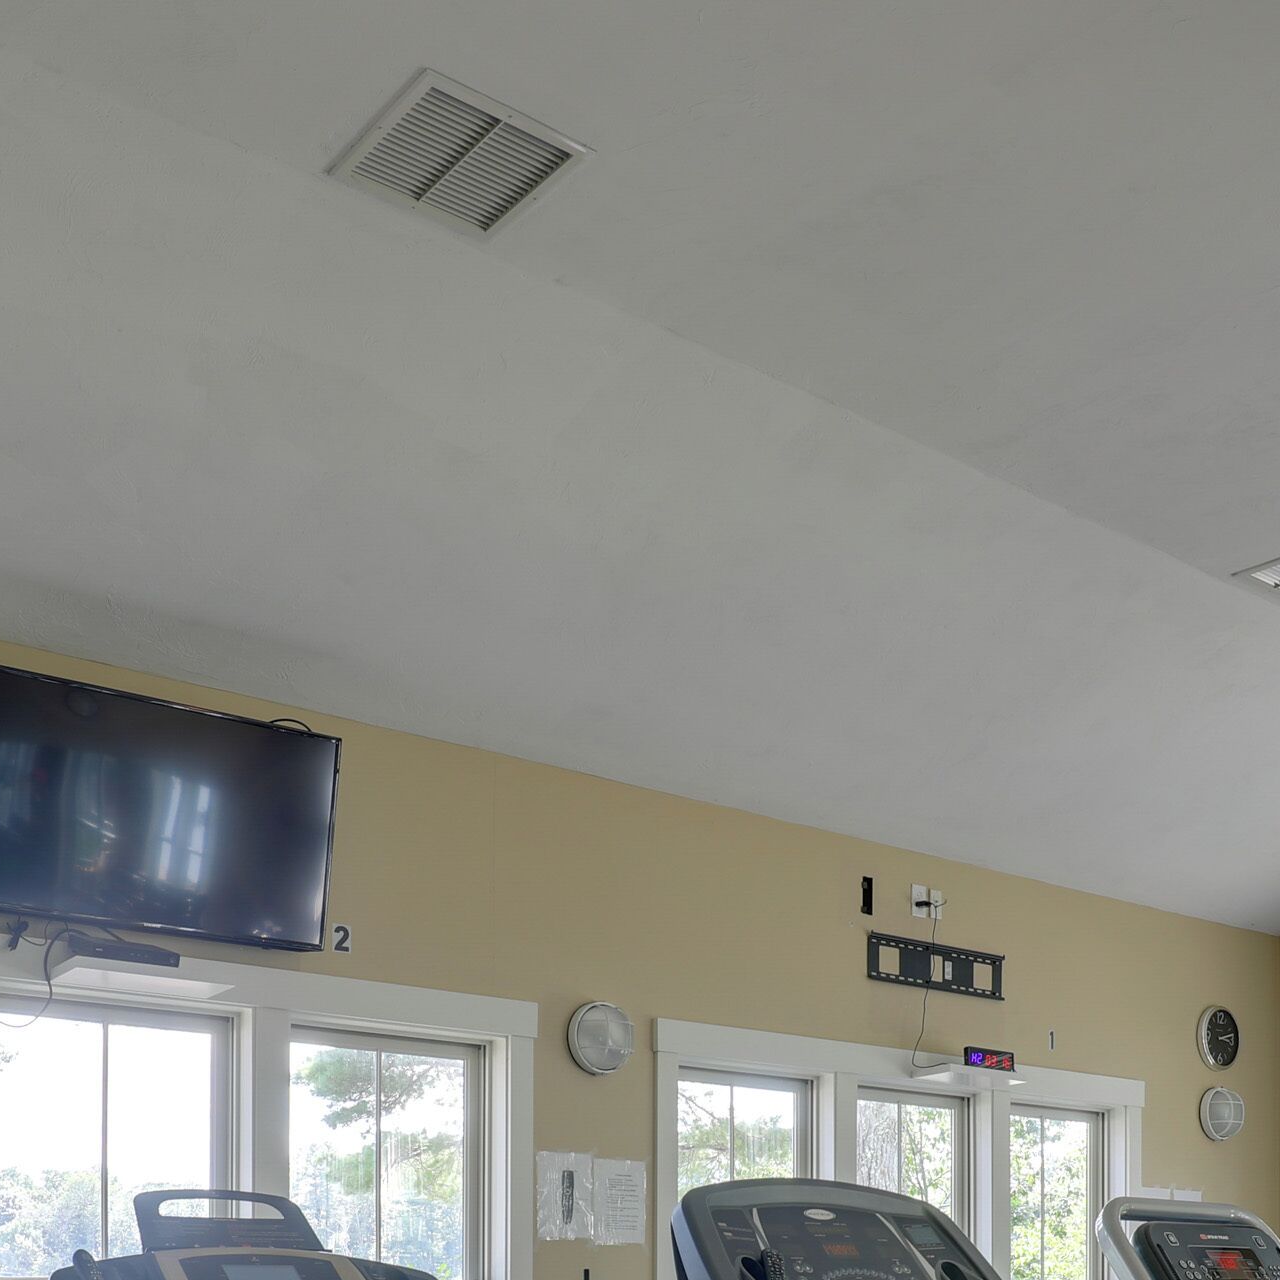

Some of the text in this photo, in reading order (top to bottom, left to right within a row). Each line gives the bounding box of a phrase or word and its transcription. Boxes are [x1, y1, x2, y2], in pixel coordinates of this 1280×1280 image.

[334, 925, 350, 953] 2
[1217, 1011, 1225, 1024] 12
[1049, 1031, 1054, 1050] 1
[1217, 1052, 1223, 1065] 6
